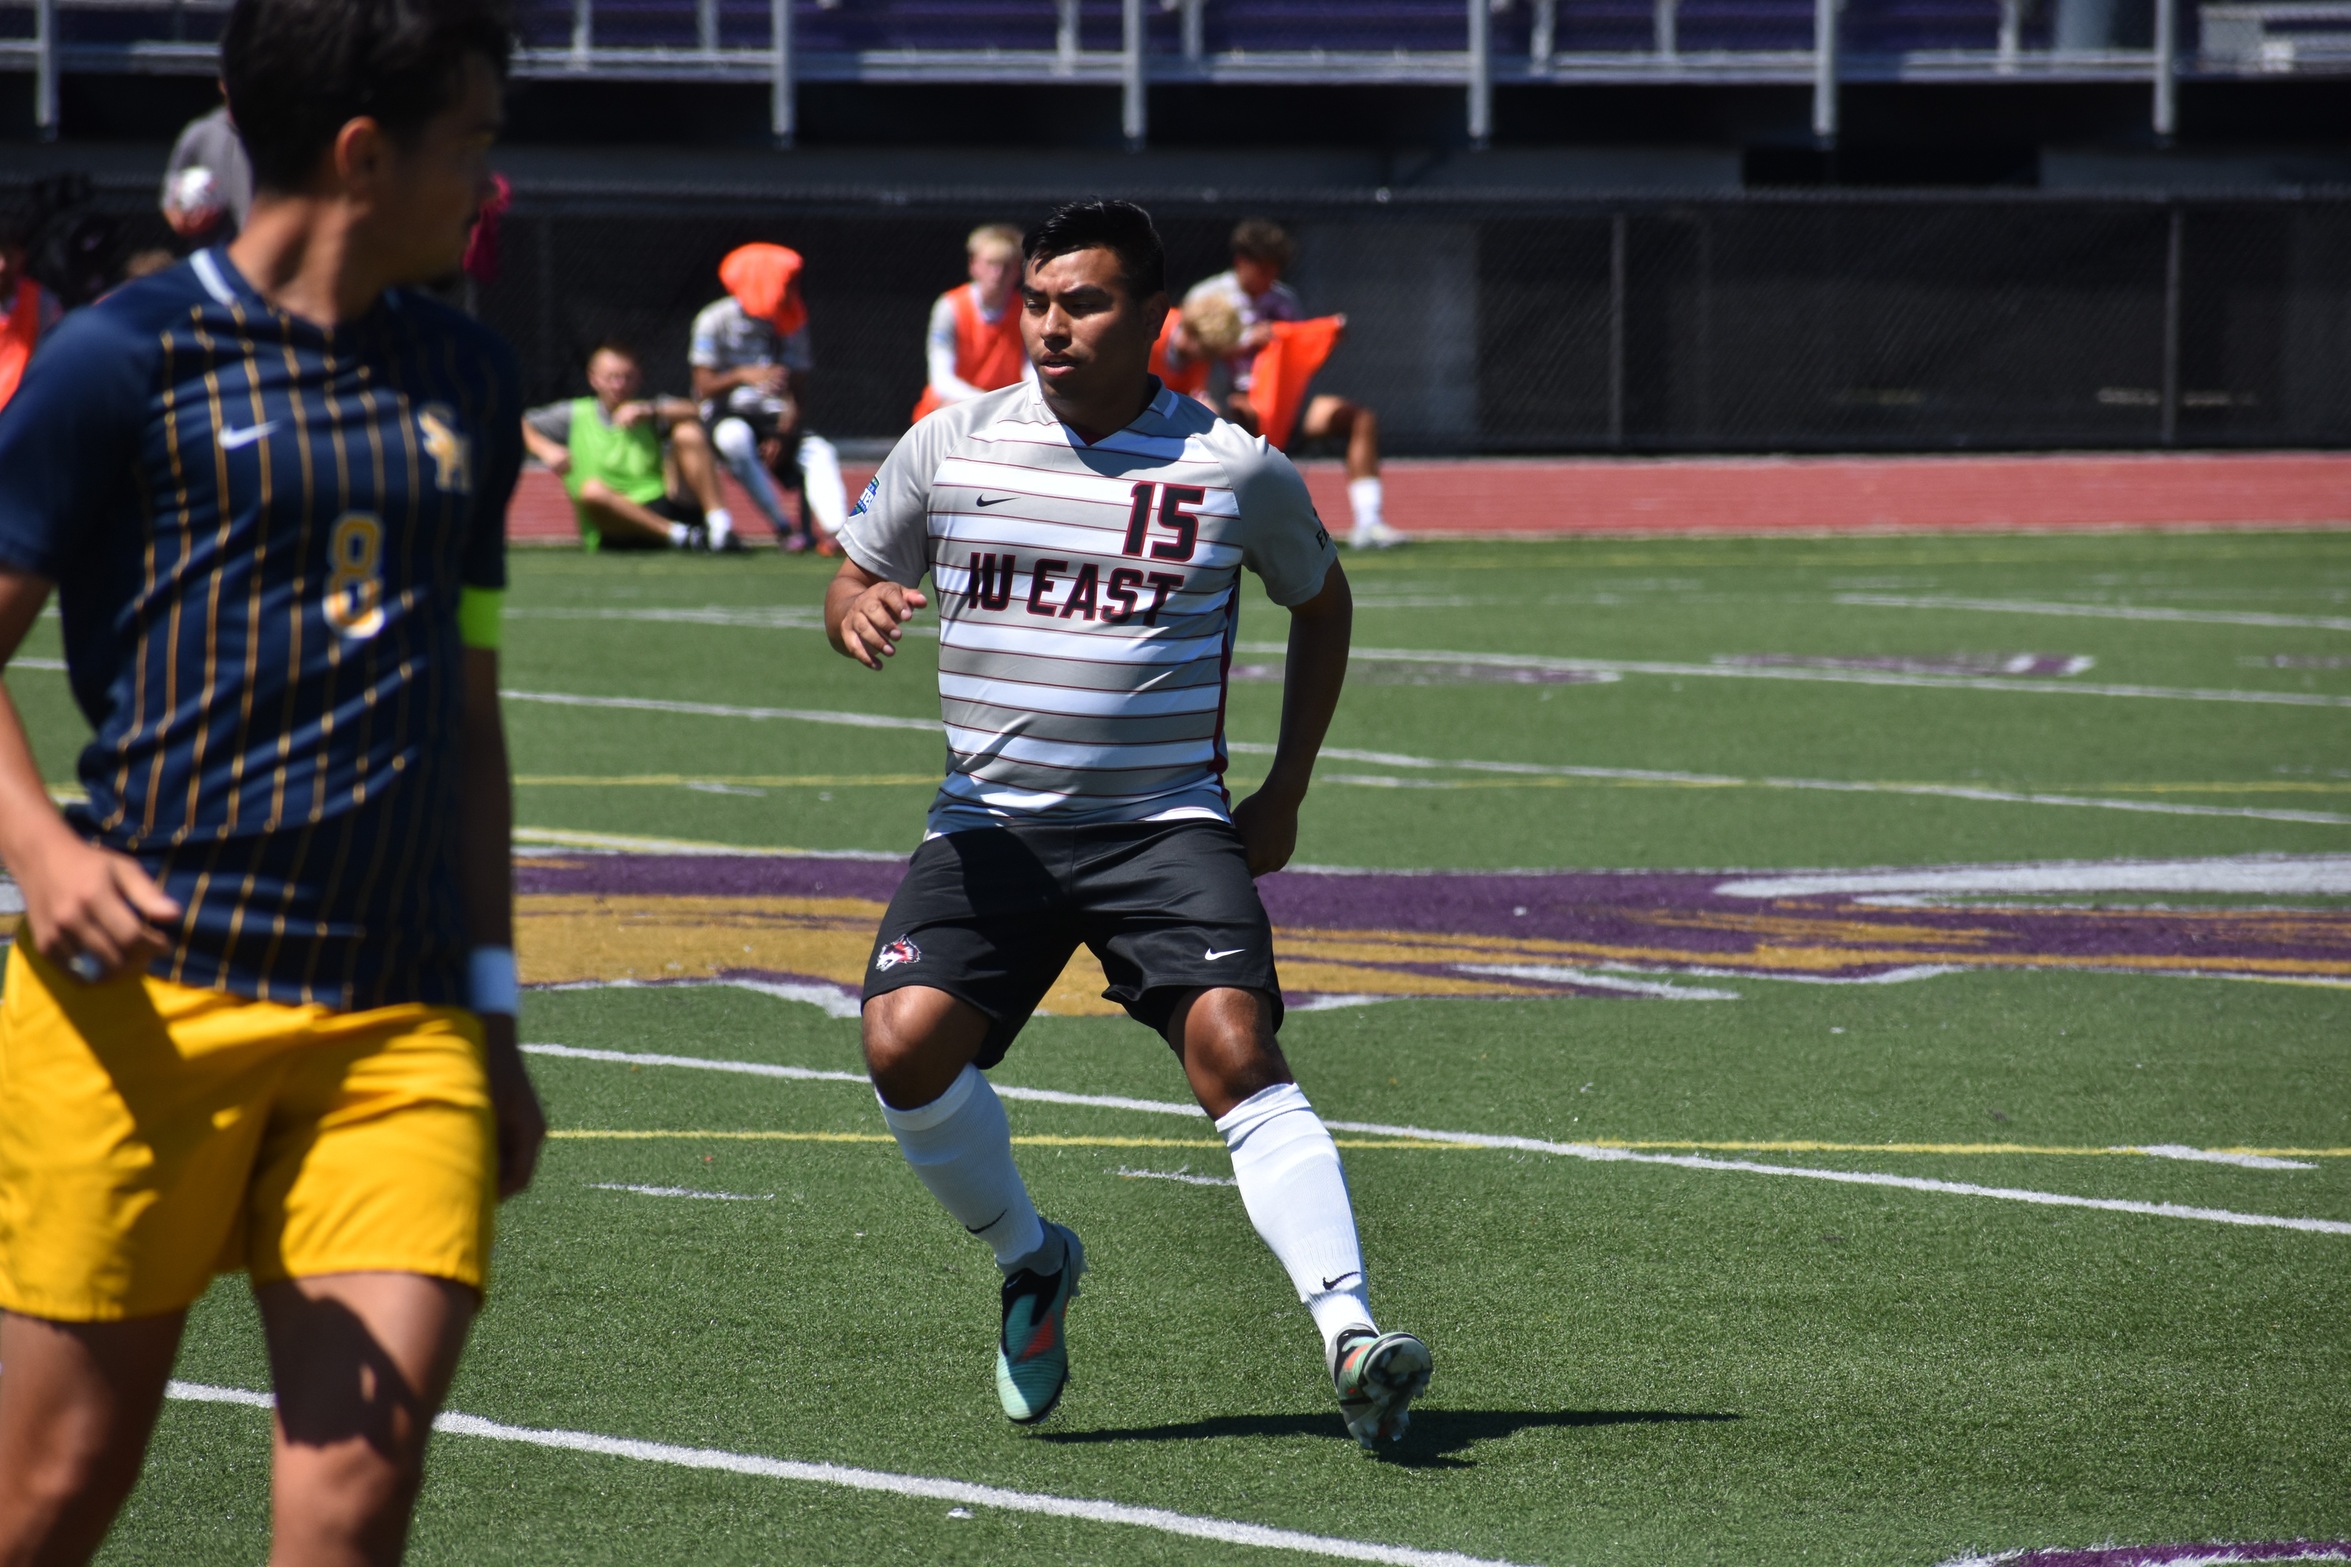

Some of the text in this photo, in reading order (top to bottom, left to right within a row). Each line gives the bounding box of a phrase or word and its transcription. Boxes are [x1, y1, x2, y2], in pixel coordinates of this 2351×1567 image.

[1122, 480, 1206, 563] 15
[322, 512, 386, 639] 8
[968, 552, 1185, 626] IU EAST
